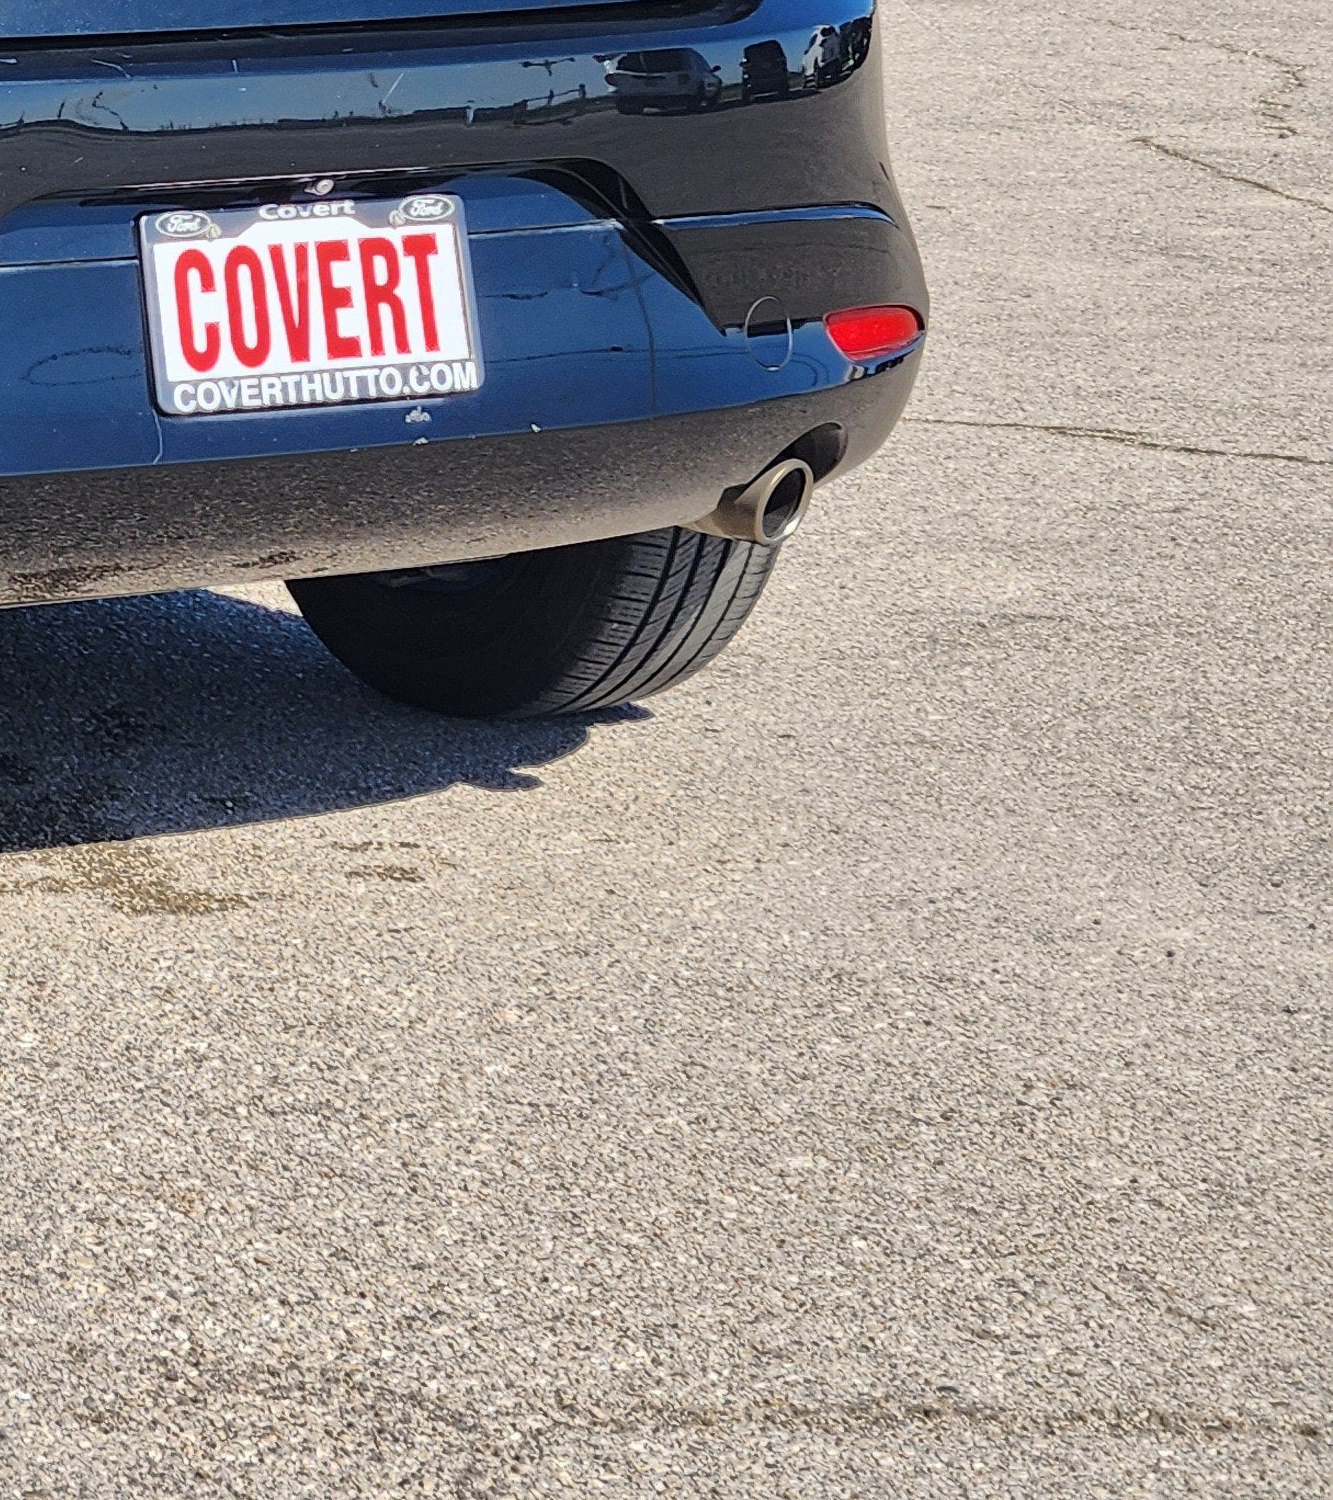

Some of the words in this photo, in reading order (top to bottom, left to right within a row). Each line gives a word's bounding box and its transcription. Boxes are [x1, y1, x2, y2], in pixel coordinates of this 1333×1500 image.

[257, 199, 357, 221] Covert
[408, 197, 447, 219] Ford
[165, 212, 204, 235] Ford
[173, 232, 441, 373] COVERT
[172, 361, 480, 414] COVERTHUTTO.COM
